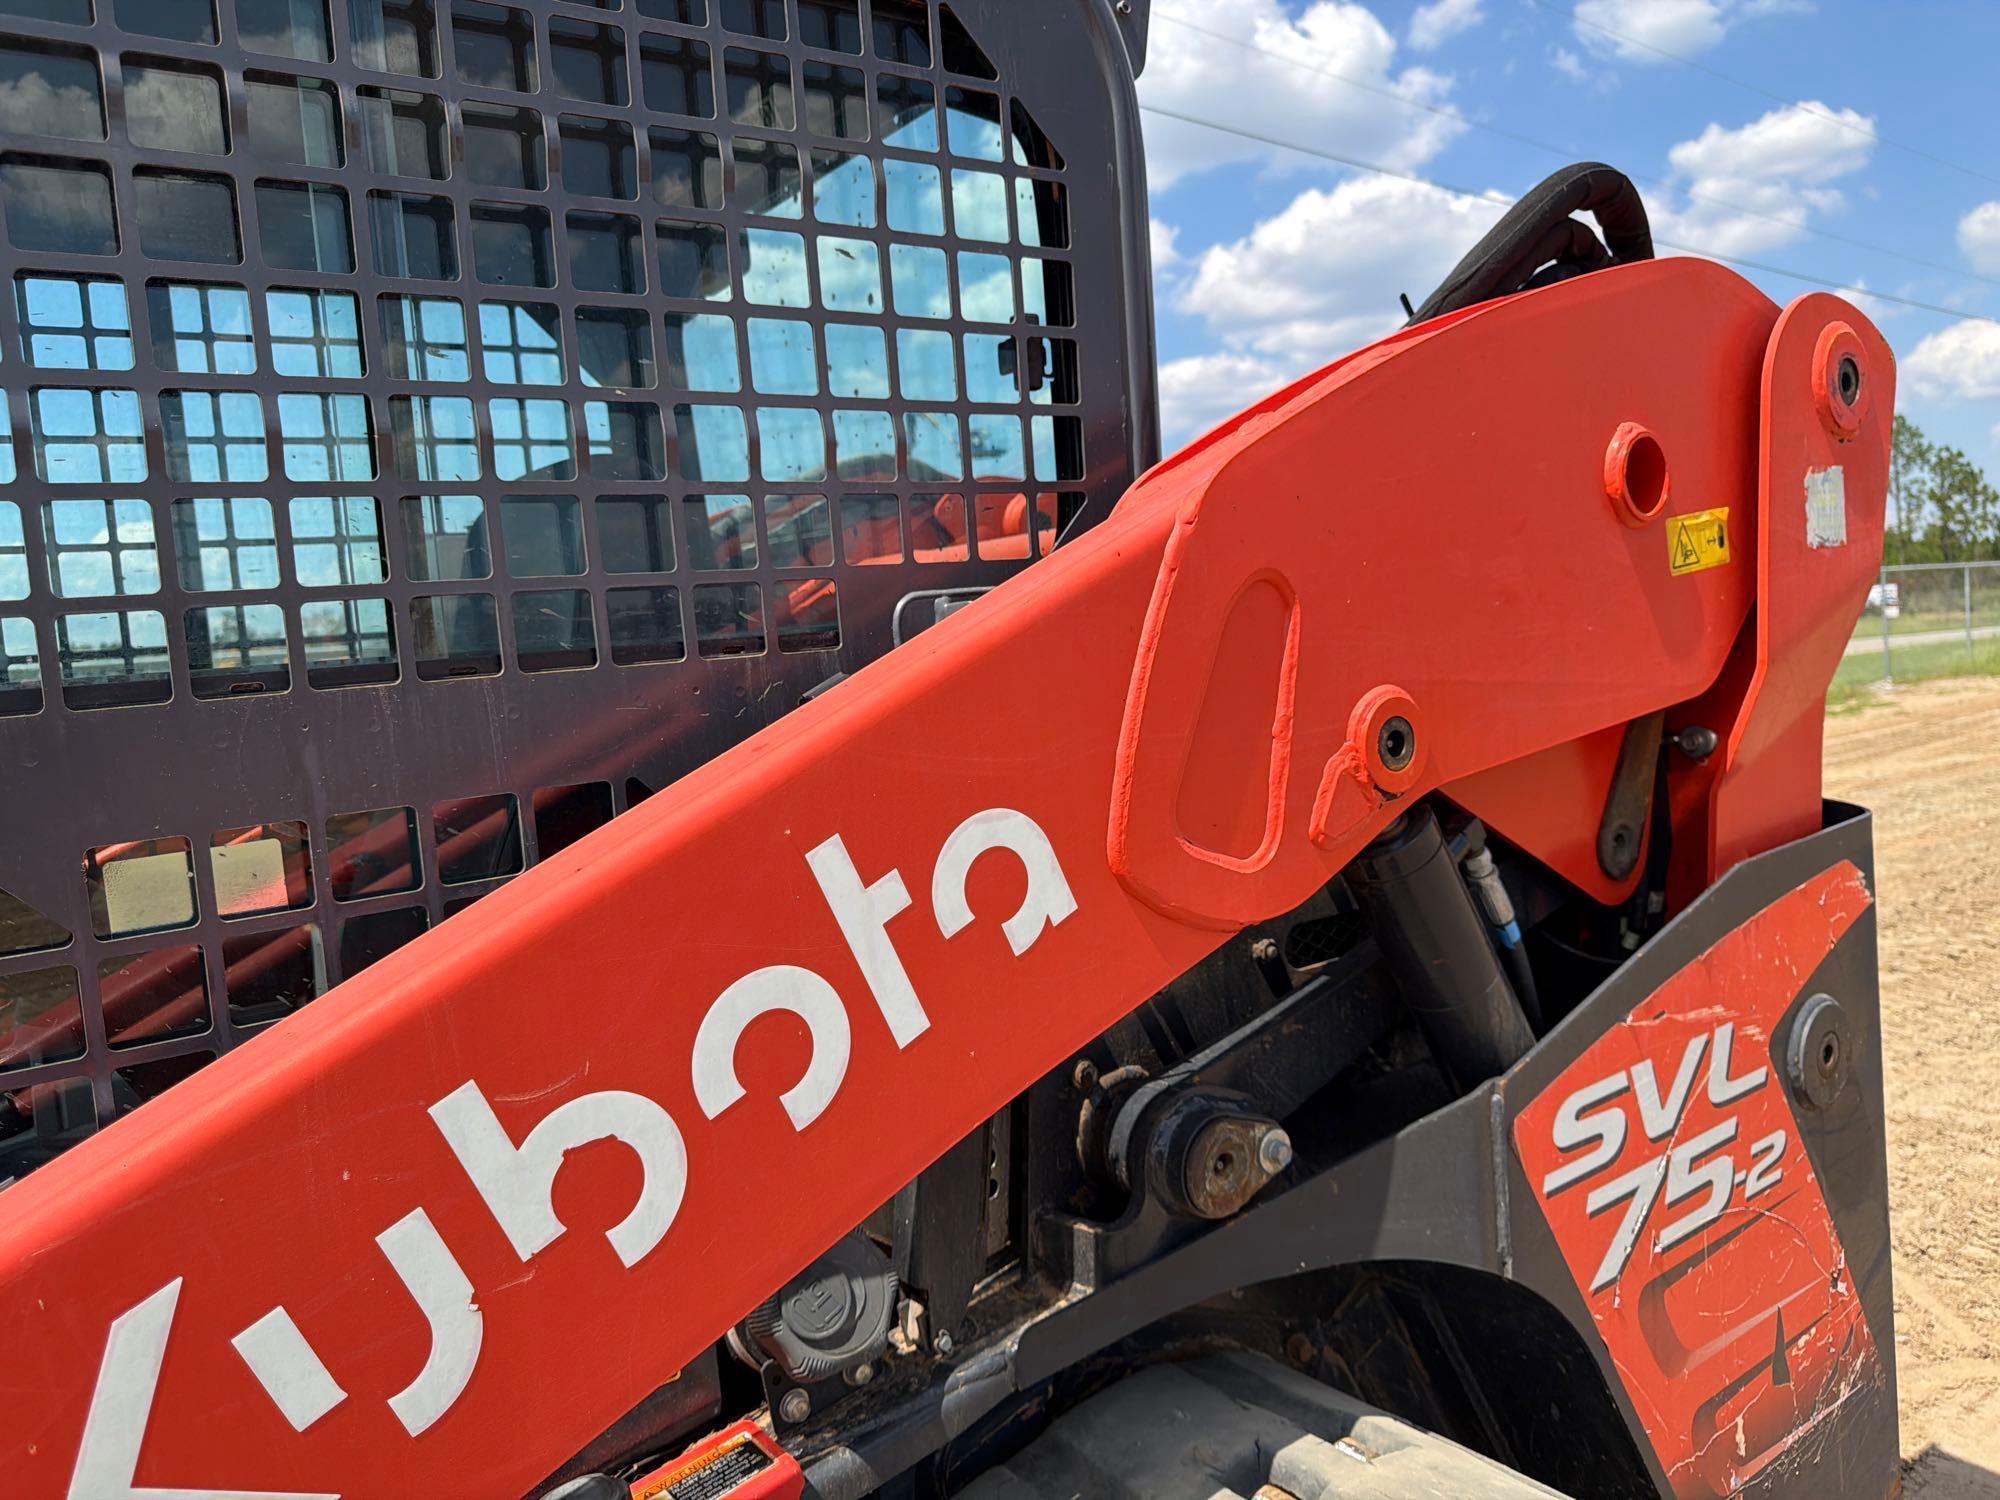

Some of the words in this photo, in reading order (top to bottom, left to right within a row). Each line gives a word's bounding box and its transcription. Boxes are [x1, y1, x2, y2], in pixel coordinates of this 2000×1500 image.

[1543, 1022, 1768, 1198] SVL
[1586, 1116, 1786, 1295] 75-2
[656, 1450, 721, 1490] WARNING
[680, 1468, 704, 1484] AVOID
[704, 1445, 744, 1469] PERSONAL
[671, 1476, 699, 1494] INJURY
